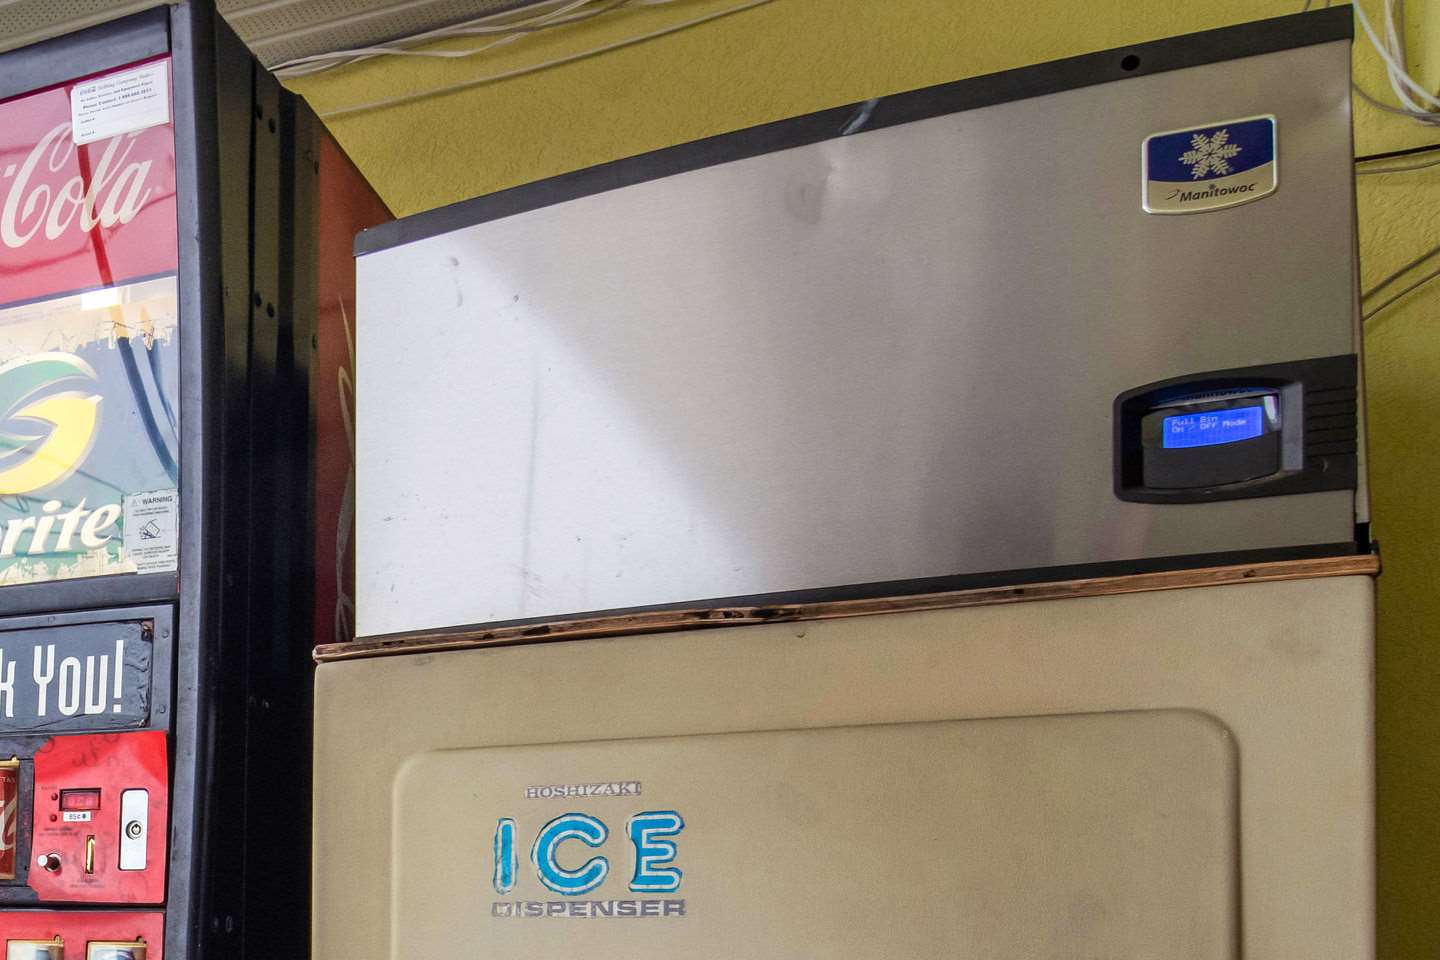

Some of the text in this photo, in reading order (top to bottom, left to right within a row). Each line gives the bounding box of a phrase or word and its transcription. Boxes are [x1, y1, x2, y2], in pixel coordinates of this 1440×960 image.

[1179, 183, 1256, 202] Manitowoc
[142, 495, 173, 505] WARNING
[33, 639, 124, 717] You!
[525, 781, 642, 798] HOSHIZAKI
[493, 810, 685, 896] ICE
[491, 899, 687, 918] DISPENSER
